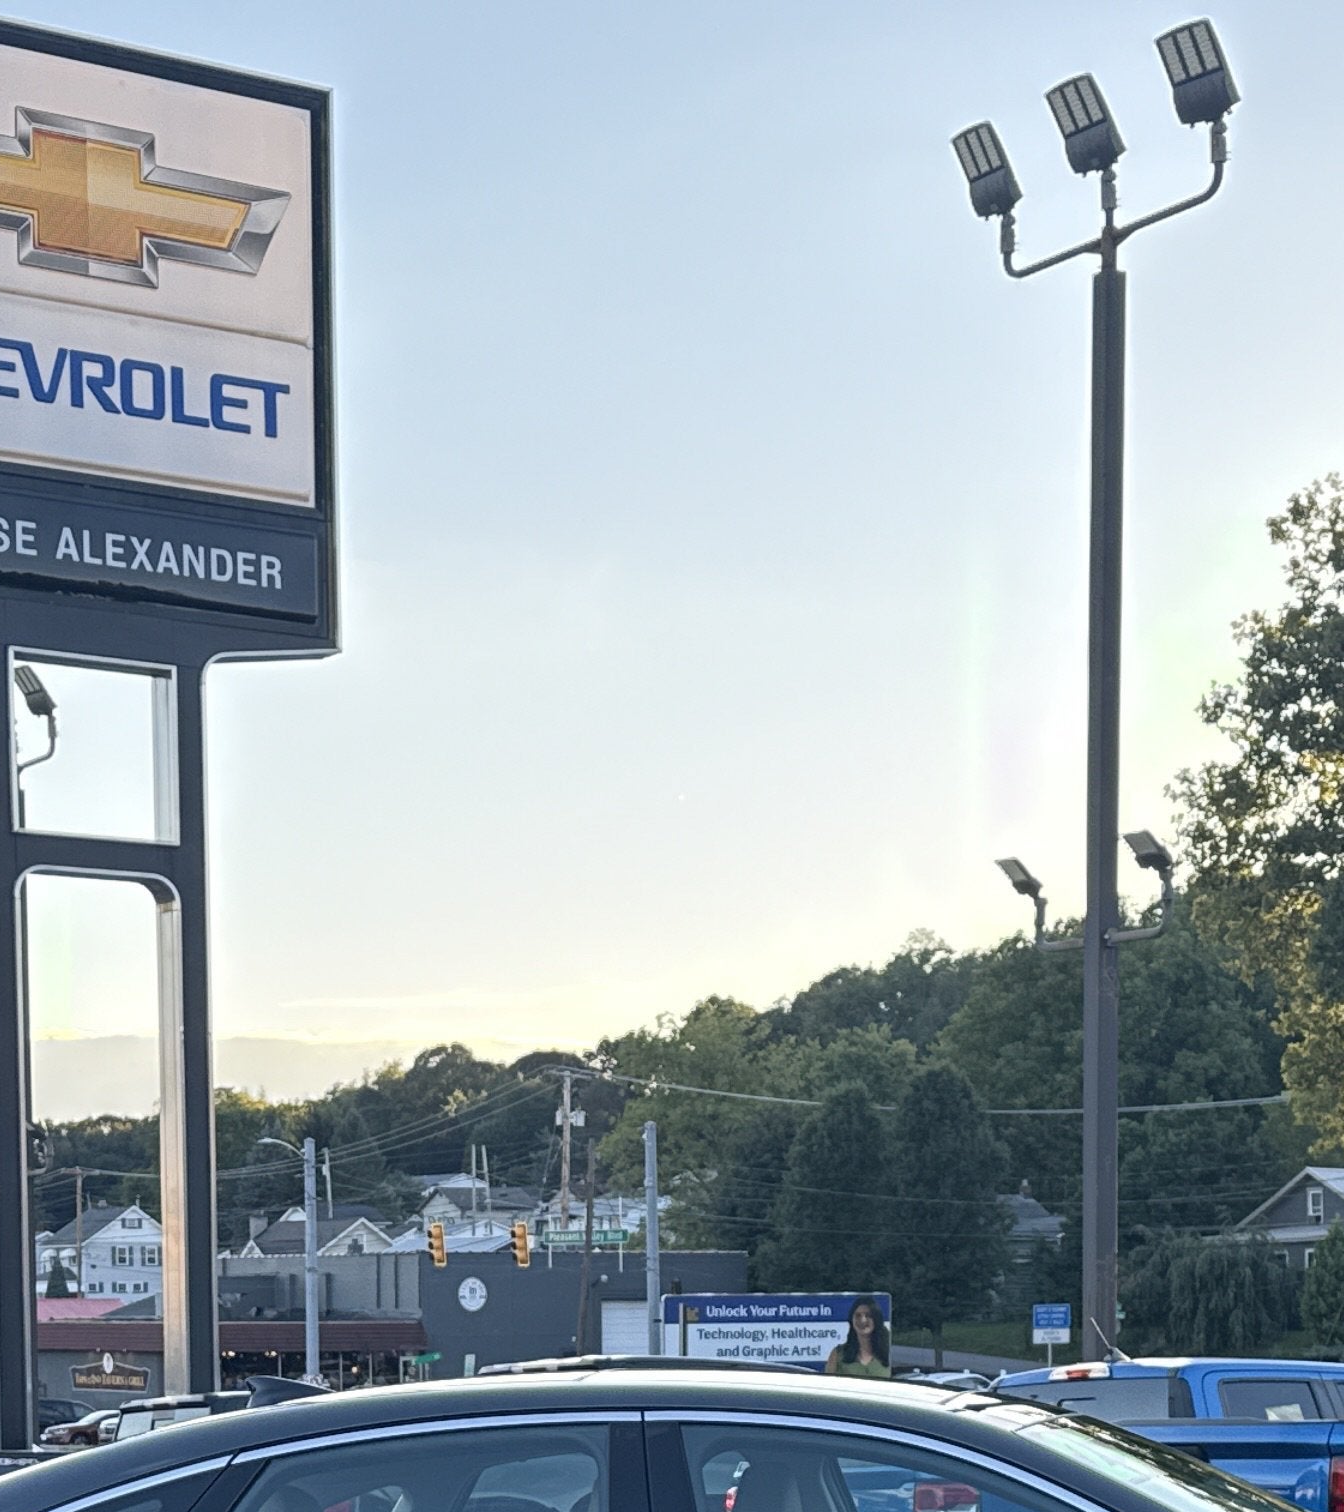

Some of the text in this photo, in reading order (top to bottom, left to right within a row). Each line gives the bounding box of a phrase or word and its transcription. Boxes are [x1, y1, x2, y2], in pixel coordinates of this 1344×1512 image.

[55, 525, 283, 590] ALEXANDER
[549, 1232, 580, 1242] Pleasant
[706, 1305, 748, 1317] Unlock
[750, 1305, 778, 1317] Your
[779, 1305, 818, 1316] Future
[697, 1328, 841, 1341] Technology, Healthcare,
[716, 1345, 822, 1360] and Graphic Arts!
